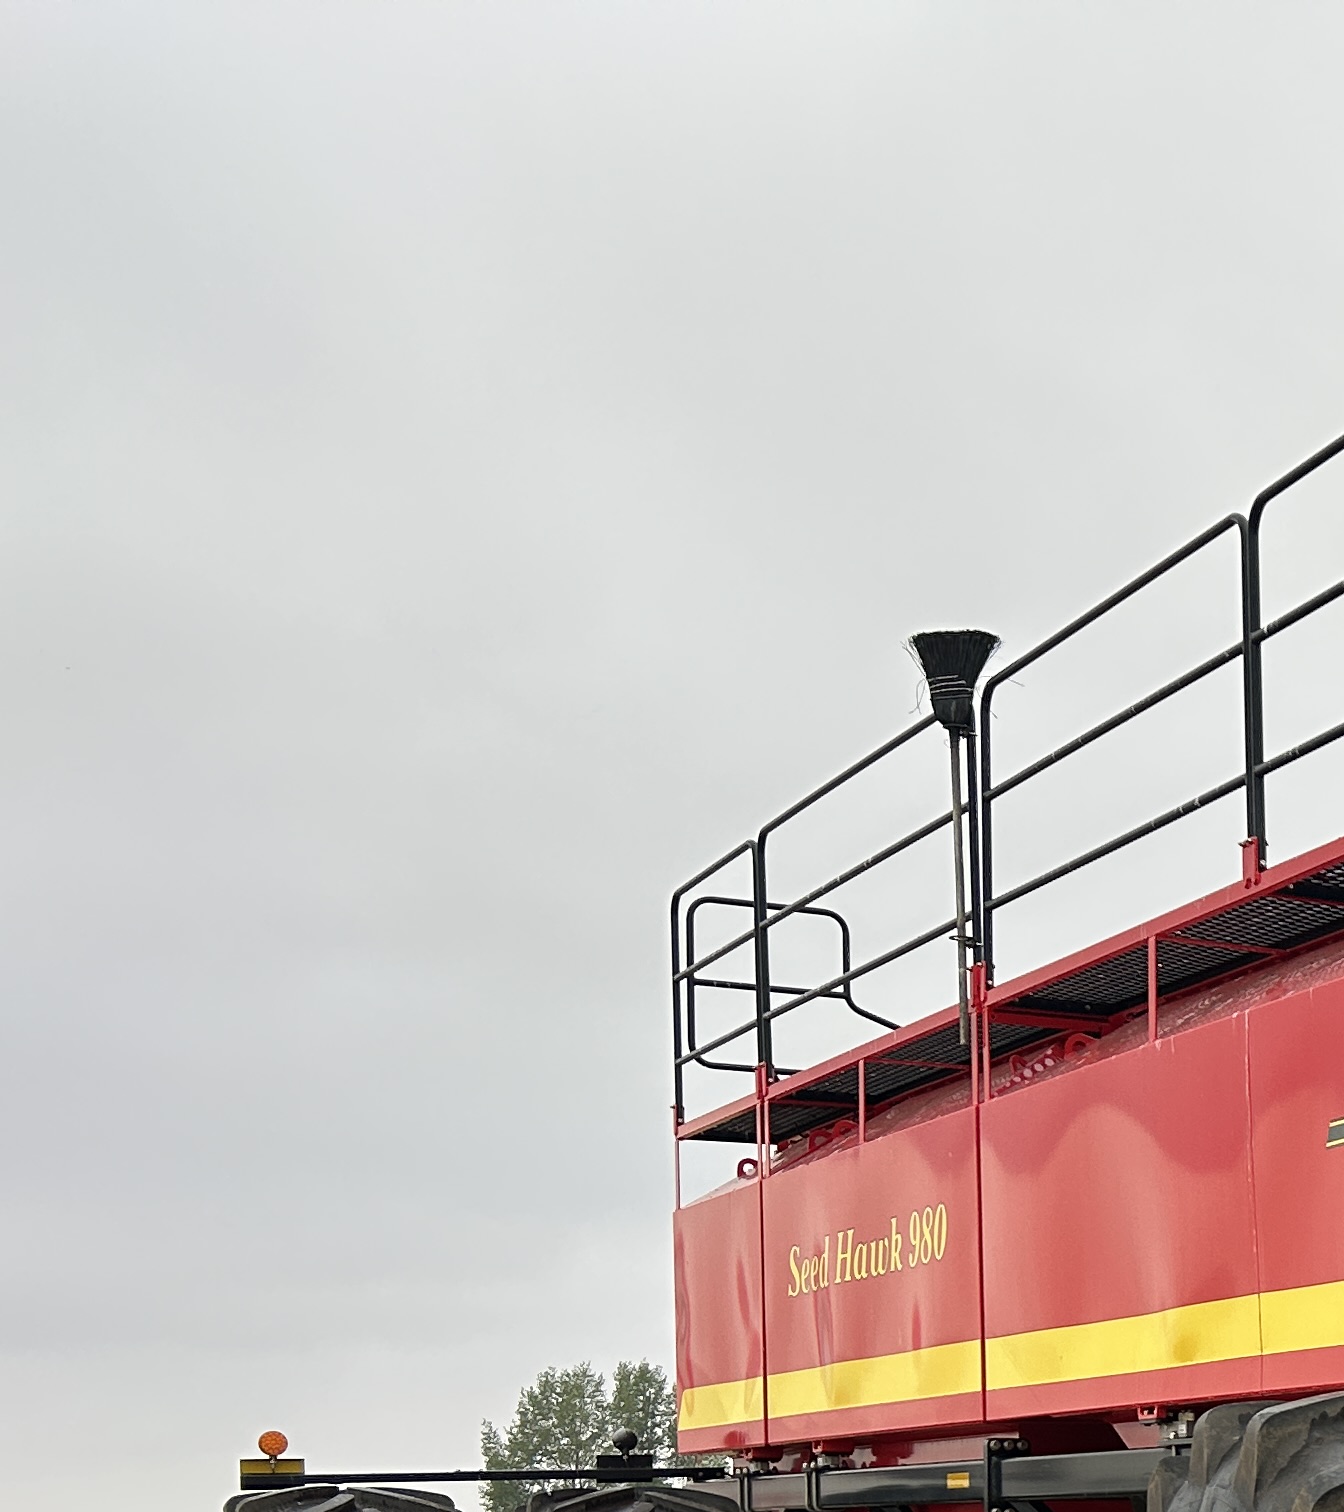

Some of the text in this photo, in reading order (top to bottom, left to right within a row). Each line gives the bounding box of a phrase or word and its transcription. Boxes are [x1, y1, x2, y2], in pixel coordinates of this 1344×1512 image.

[787, 1203, 948, 1297] Seed Hawk 980
